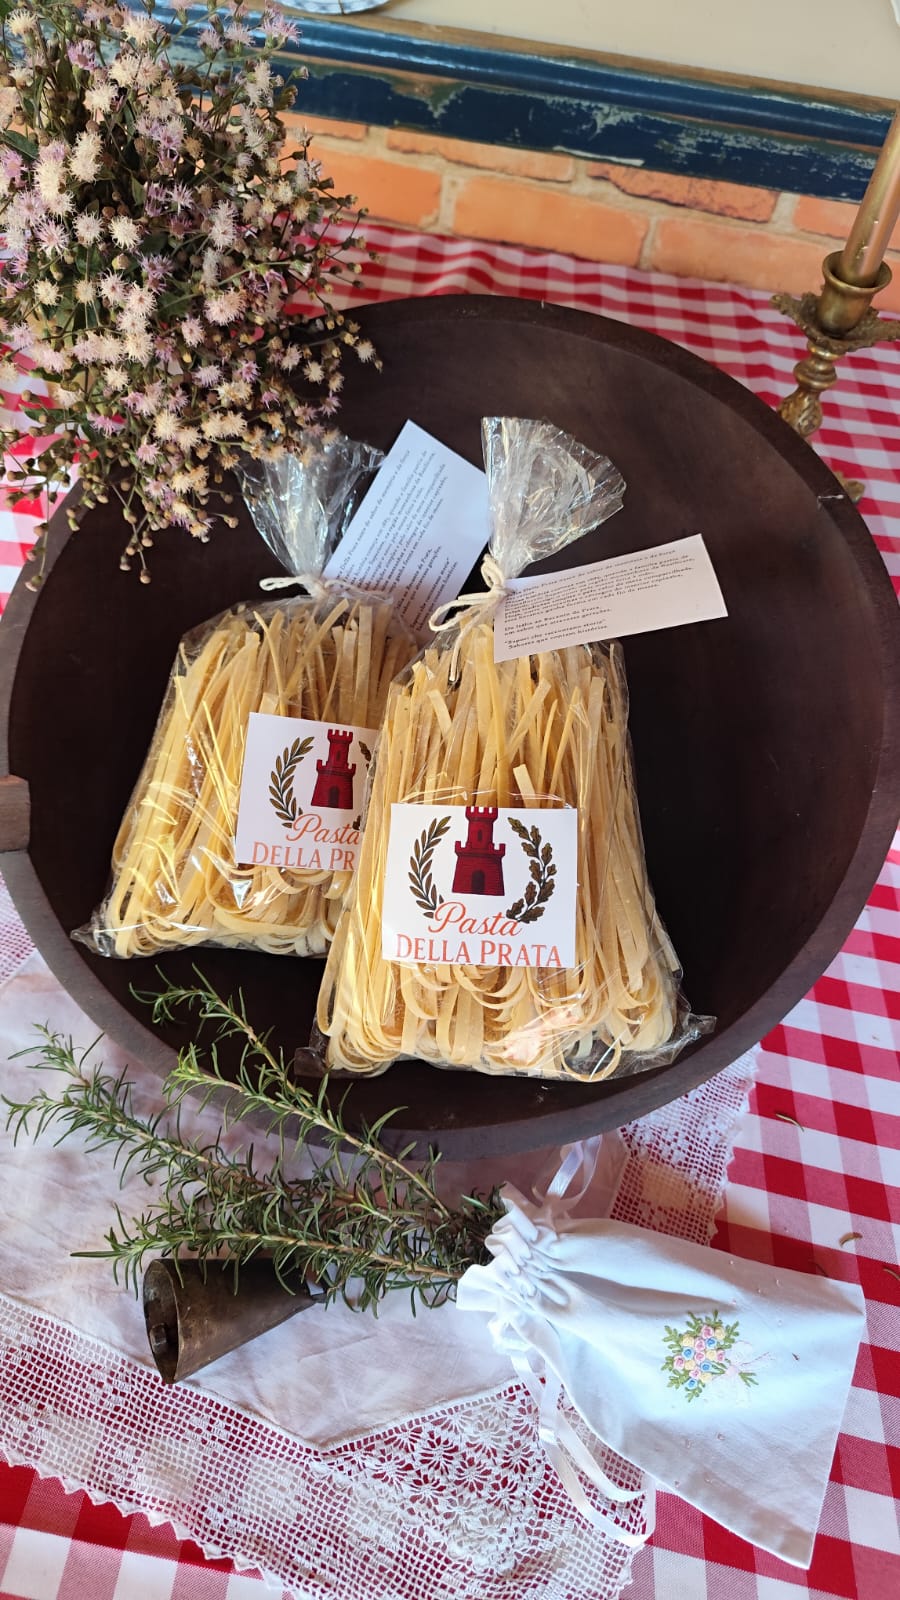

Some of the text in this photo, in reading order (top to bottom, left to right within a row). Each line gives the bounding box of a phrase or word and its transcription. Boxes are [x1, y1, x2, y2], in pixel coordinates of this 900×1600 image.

[285, 815, 360, 845] Pasta
[252, 842, 356, 871] DELLA PR
[428, 902, 523, 937] Pasta
[397, 934, 563, 968] DELLA PRATA
